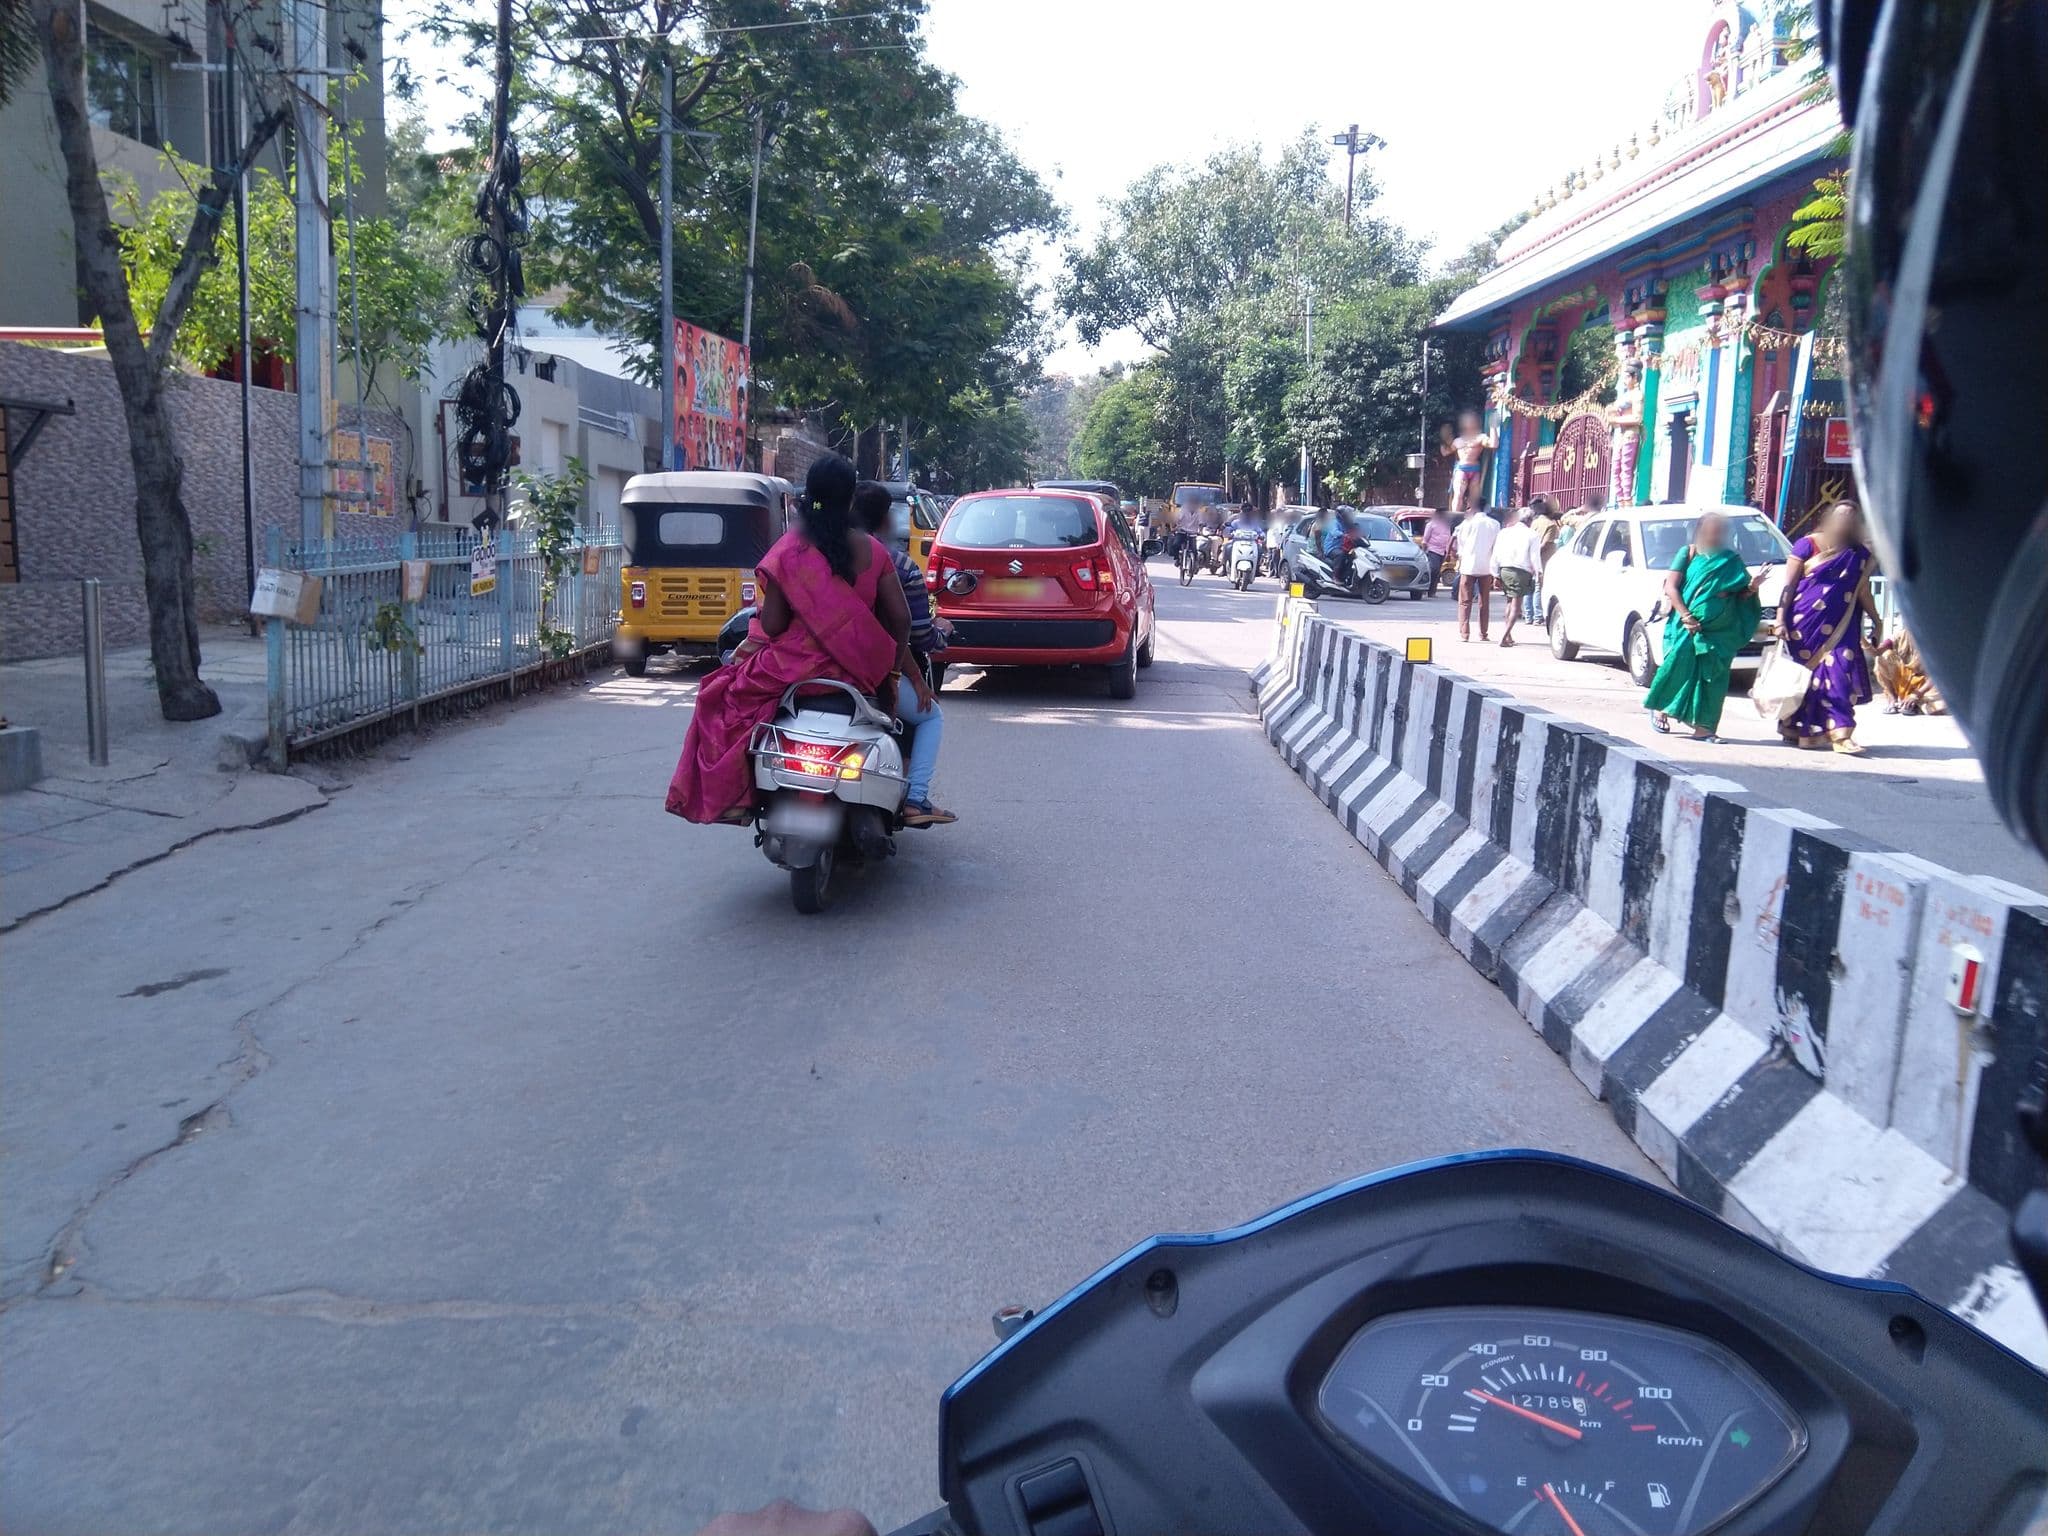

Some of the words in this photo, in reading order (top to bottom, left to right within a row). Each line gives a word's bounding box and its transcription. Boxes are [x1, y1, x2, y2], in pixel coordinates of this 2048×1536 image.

[1523, 1335, 1551, 1347] 60
[1468, 1343, 1498, 1355] 40
[1580, 1350, 1608, 1362] 80
[1480, 1355, 1515, 1370] ECONOMY
[1421, 1374, 1449, 1387] 20
[1638, 1387, 1673, 1400] 100
[1407, 1418, 1423, 1431] 0
[1579, 1419, 1602, 1429] km
[1656, 1434, 1704, 1447] km/h
[1516, 1476, 1527, 1487] E
[1604, 1480, 1615, 1491] F
